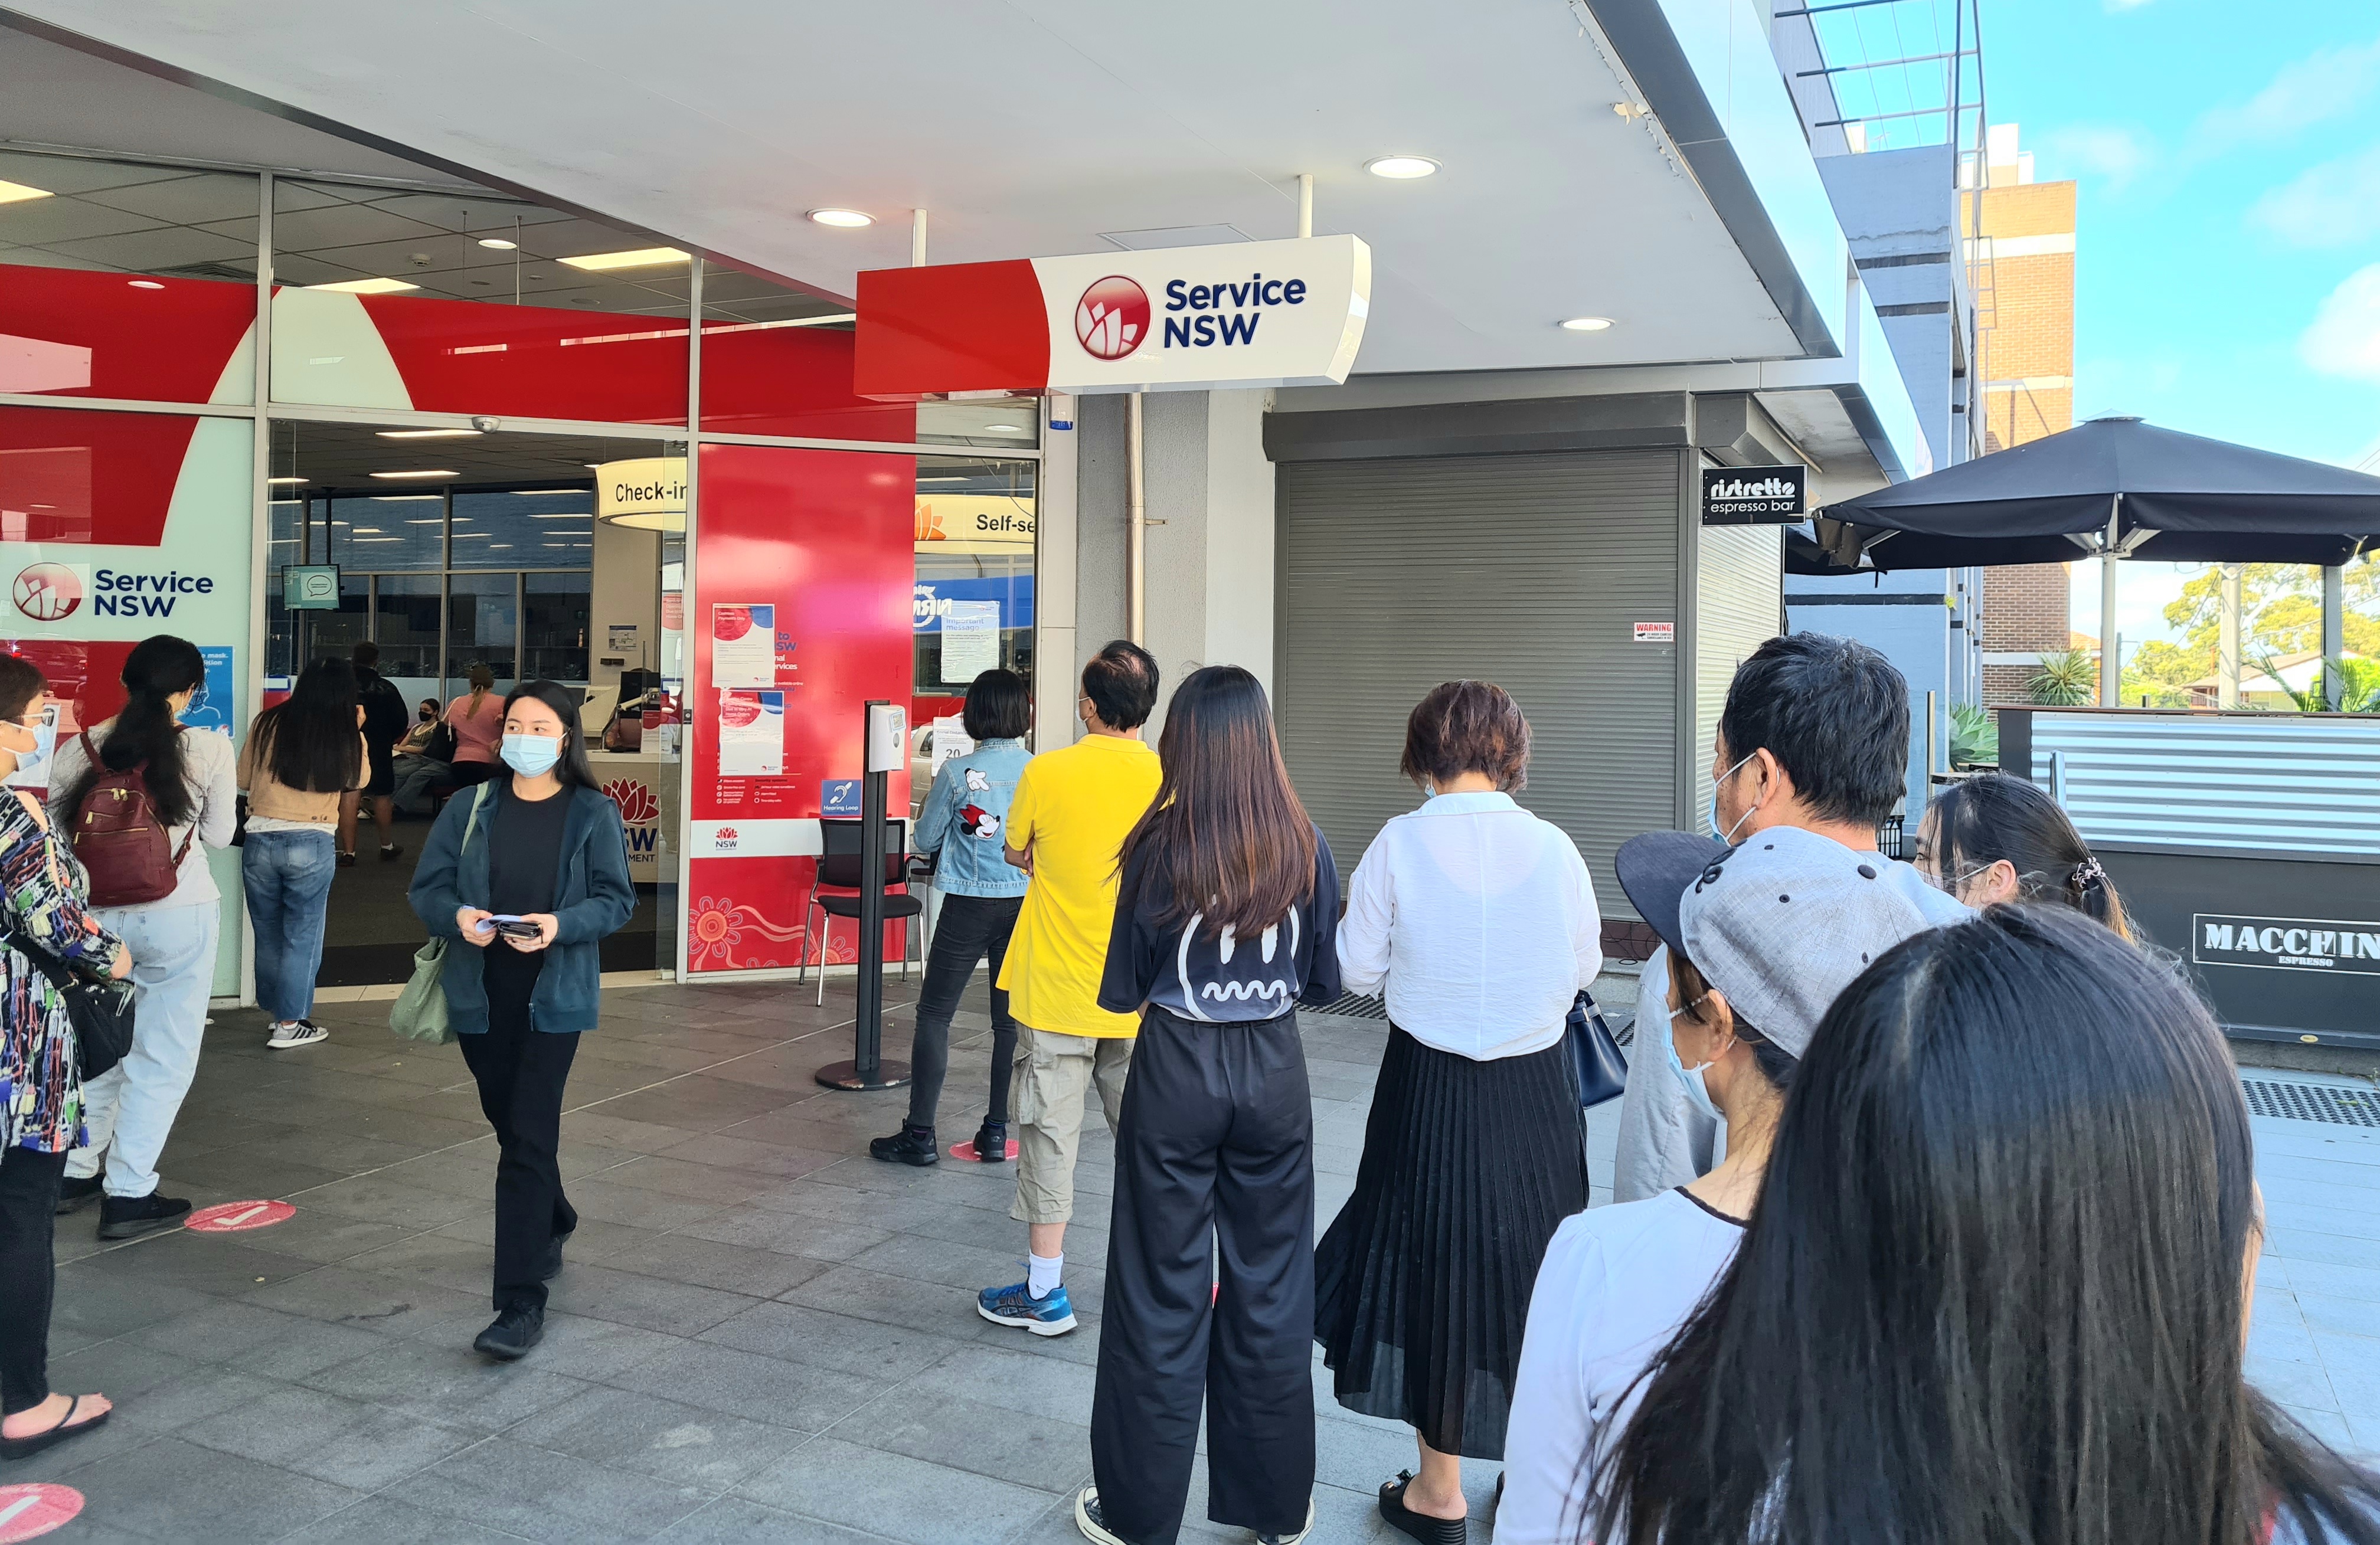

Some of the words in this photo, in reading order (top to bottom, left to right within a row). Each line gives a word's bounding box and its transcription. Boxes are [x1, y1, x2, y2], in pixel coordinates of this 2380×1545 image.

[1165, 273, 1307, 311] Service
[1164, 312, 1261, 348] NSW
[1711, 477, 1796, 497] ristretto
[1711, 502, 1767, 515] espresso
[1771, 499, 1796, 511] bar
[95, 569, 214, 594] Service
[94, 594, 176, 617] NSW
[777, 631, 790, 640] to
[774, 641, 797, 651] SW
[946, 748, 960, 759] 20
[2278, 955, 2334, 967] ESPRESSO
